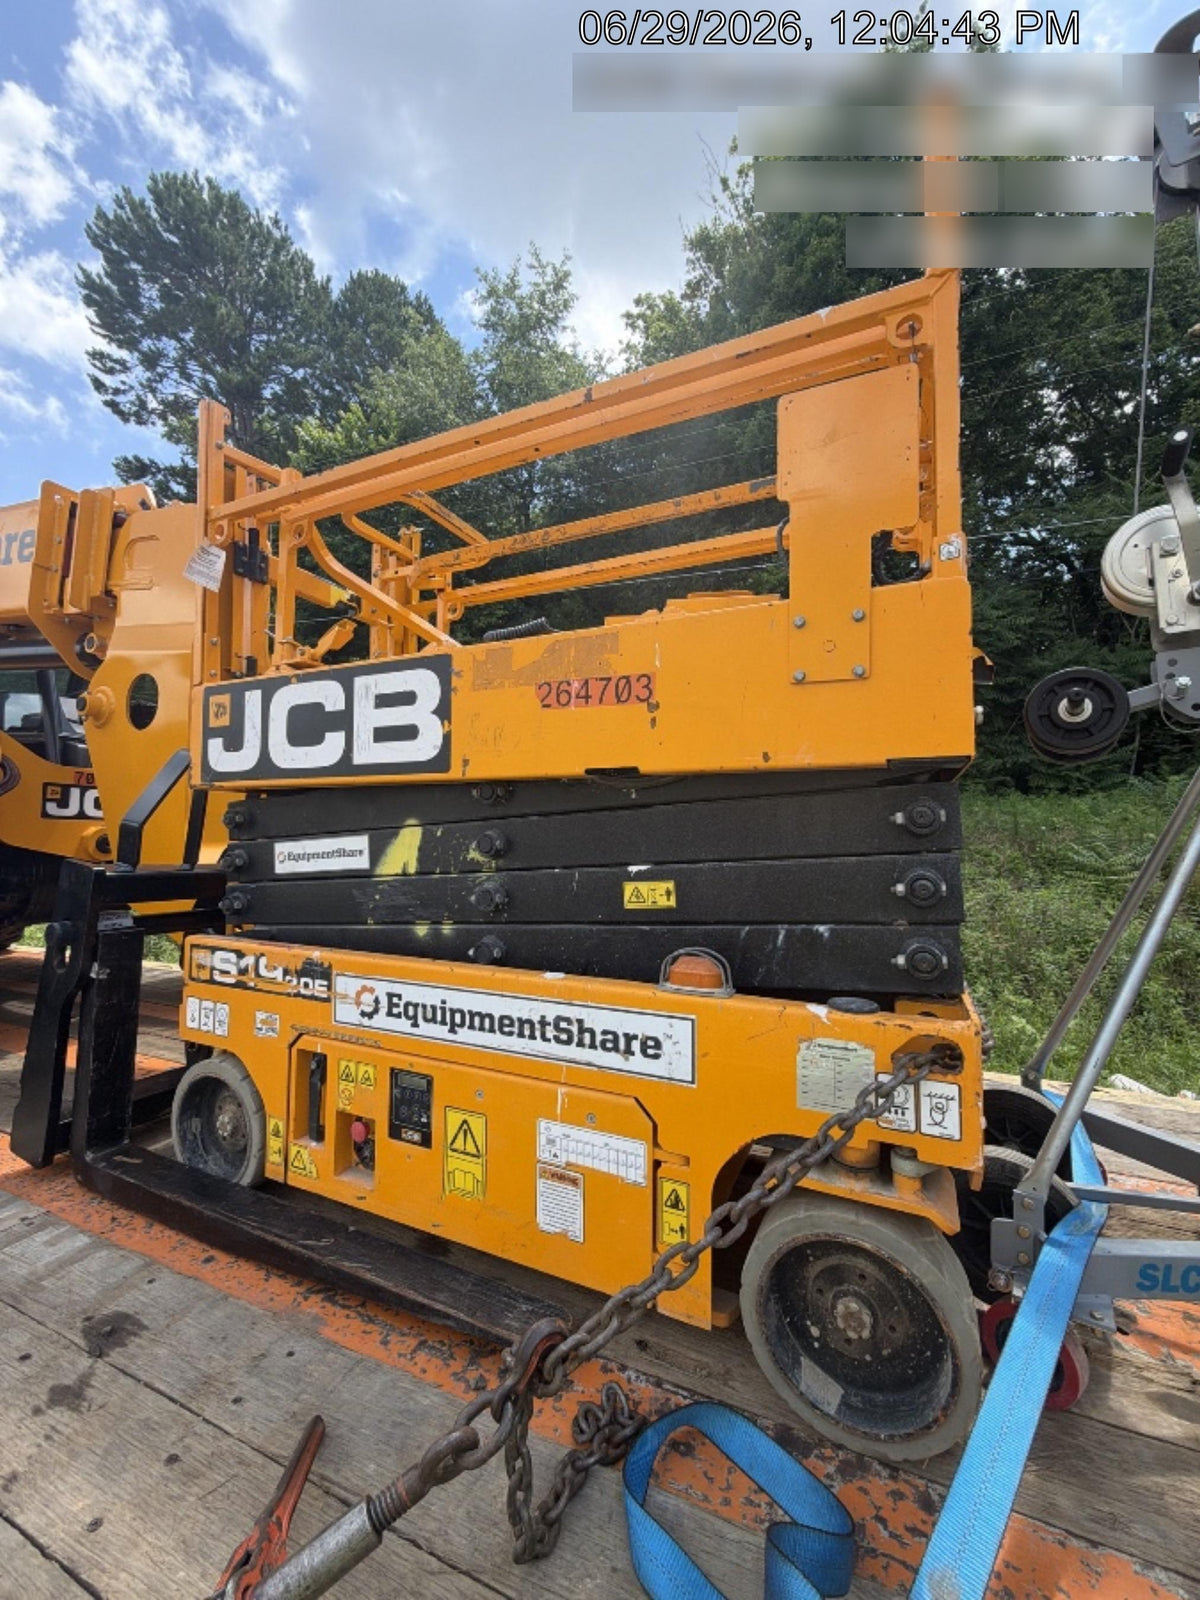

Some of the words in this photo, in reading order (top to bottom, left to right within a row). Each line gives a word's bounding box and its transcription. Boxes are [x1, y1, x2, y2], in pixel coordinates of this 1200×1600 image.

[0, 529, 36, 566] re
[538, 673, 654, 708] 264703
[207, 668, 444, 772] JCB
[287, 847, 364, 863] EquipmentShare
[385, 992, 664, 1061] EquipmentShare
[1136, 1263, 1200, 1294] SLC
